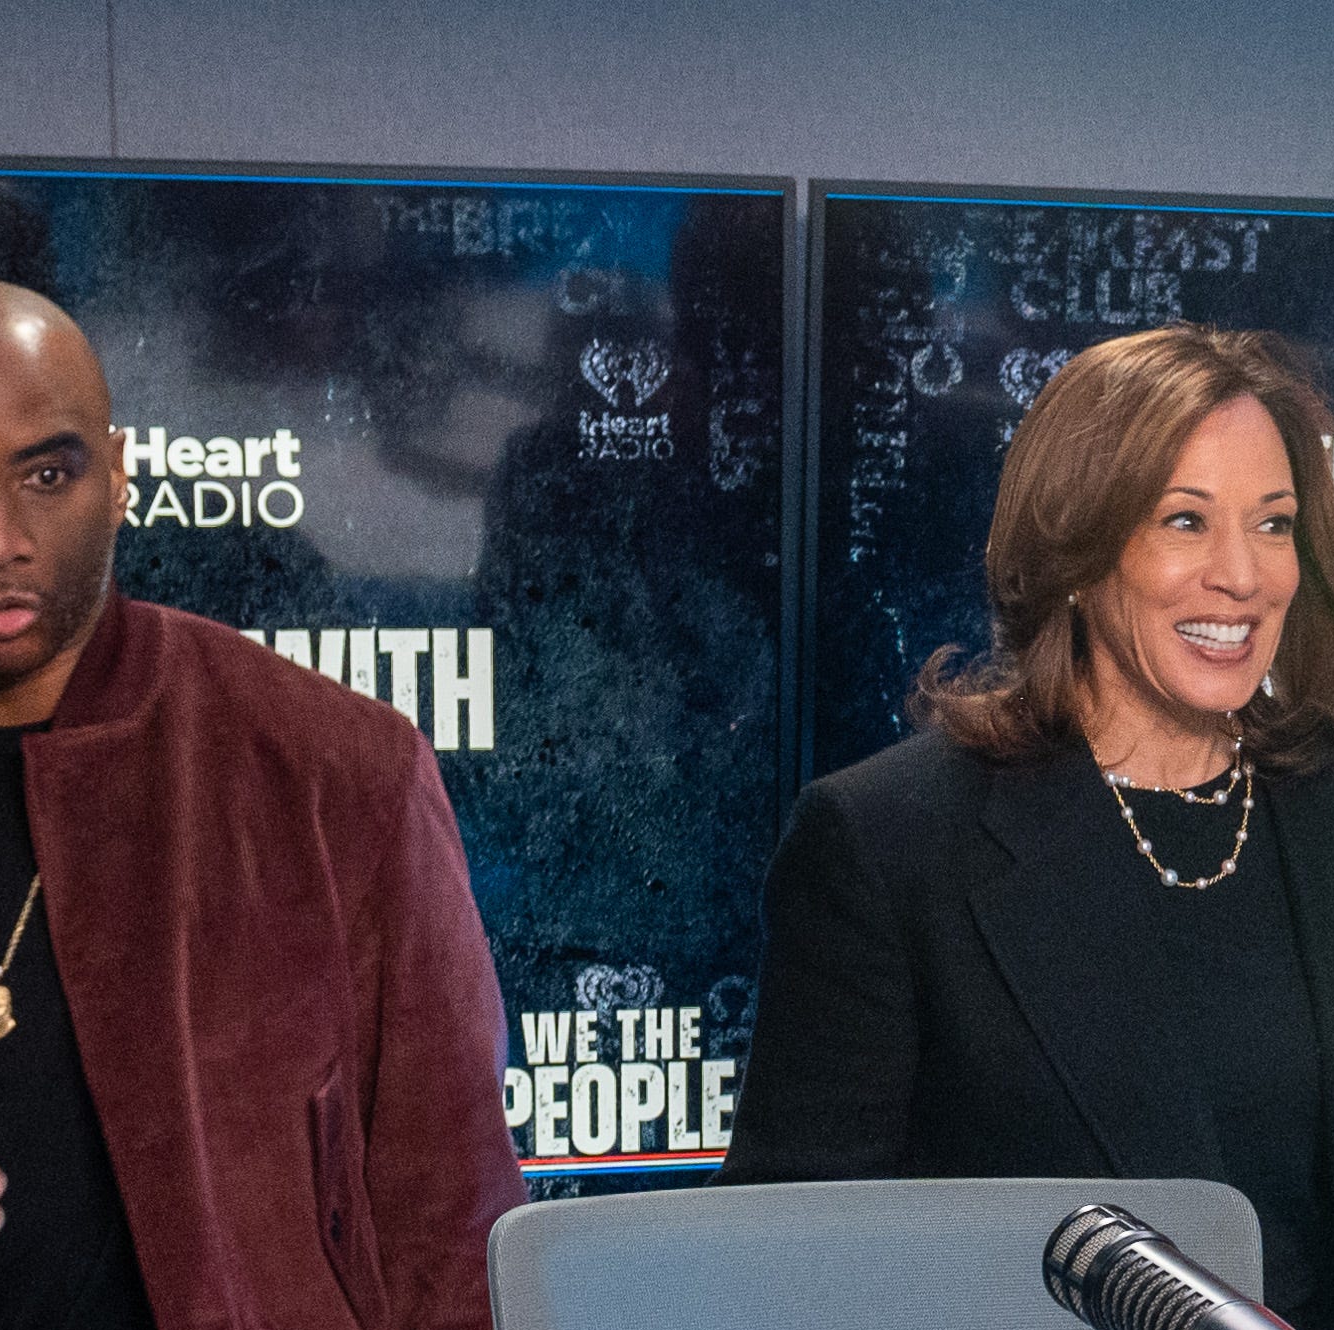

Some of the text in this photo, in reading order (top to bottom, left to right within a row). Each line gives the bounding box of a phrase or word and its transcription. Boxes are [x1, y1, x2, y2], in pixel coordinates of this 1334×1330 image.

[109, 425, 302, 479] Heart
[521, 1010, 598, 1065] WE
[617, 1006, 702, 1062] THE
[502, 1059, 736, 1157] PEOPLE
